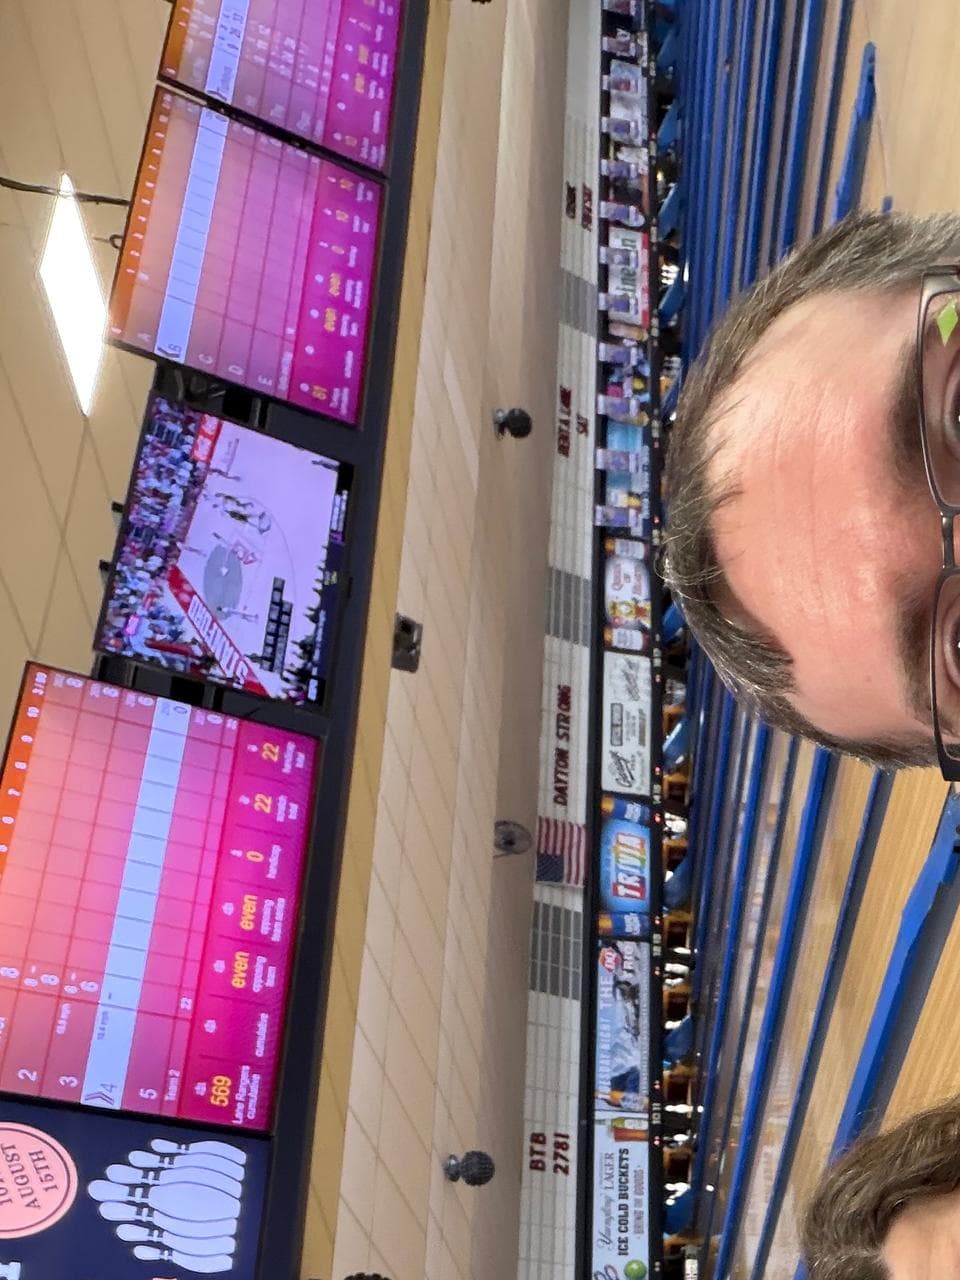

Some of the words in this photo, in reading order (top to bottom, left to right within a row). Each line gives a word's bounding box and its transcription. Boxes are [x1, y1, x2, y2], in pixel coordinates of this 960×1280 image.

[555, 684, 571, 742] STRONG
[262, 741, 280, 762] 22
[552, 747, 569, 807] DAYTON
[253, 793, 273, 814] 22
[245, 850, 265, 863] 0
[612, 831, 643, 899] TRIVIA
[240, 894, 258, 931] even
[231, 951, 250, 989] even
[599, 975, 613, 1009] THE
[17, 1069, 38, 1082] 2
[58, 1075, 79, 1088] 3
[100, 1083, 118, 1093] 4
[209, 1075, 232, 1107] 569
[139, 1088, 158, 1100] 5
[528, 1132, 547, 1172] BTB
[552, 1132, 570, 1176] 2781
[1, 1143, 41, 1210] AUGUST
[28, 1150, 58, 1192] 15TH
[603, 1152, 615, 1190] LAGER
[618, 1147, 630, 1200] BUCKETS
[617, 1203, 629, 1233] COLD
[617, 1237, 629, 1256] ICE
